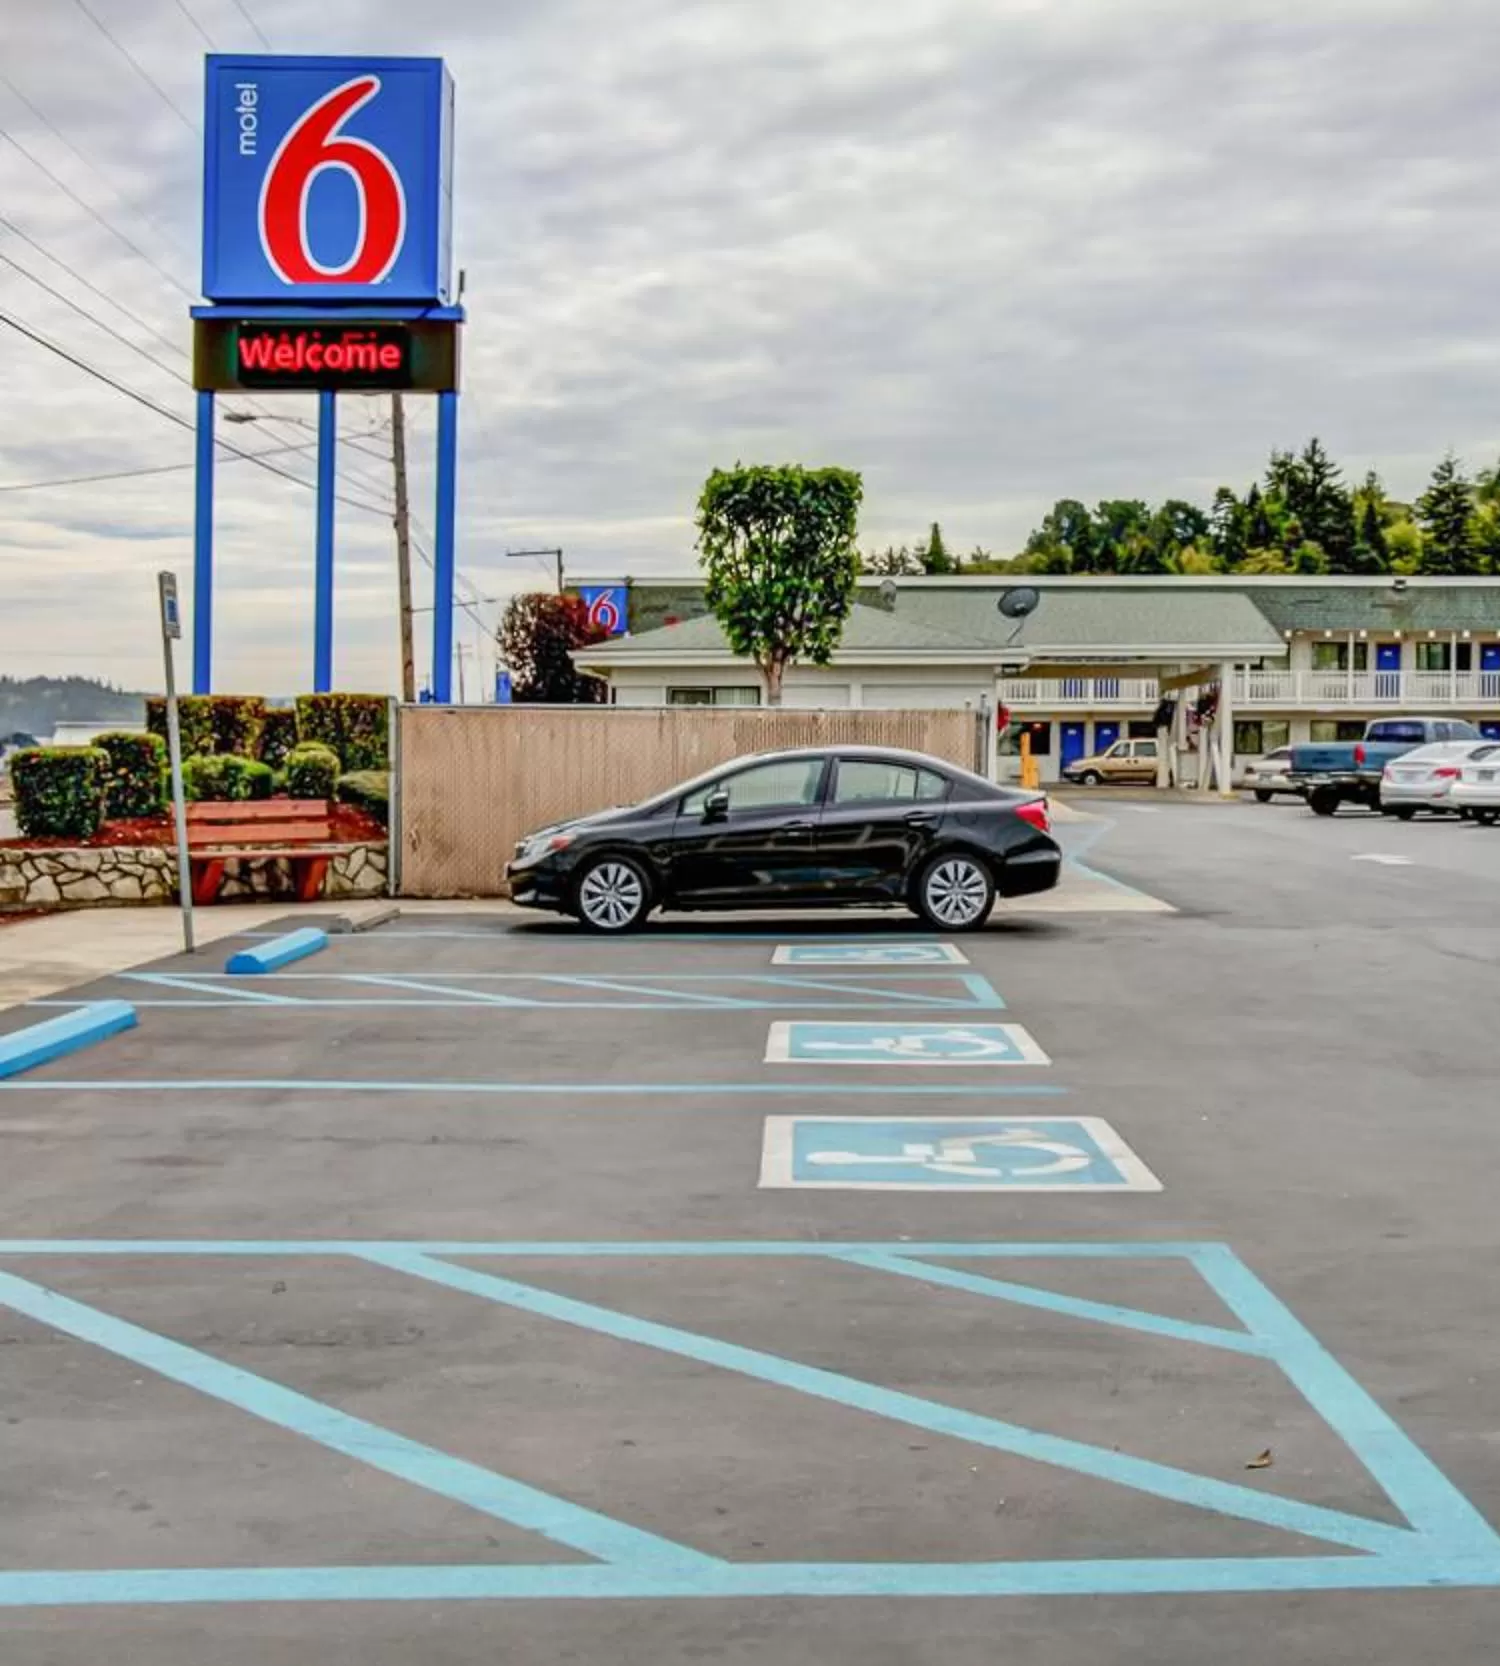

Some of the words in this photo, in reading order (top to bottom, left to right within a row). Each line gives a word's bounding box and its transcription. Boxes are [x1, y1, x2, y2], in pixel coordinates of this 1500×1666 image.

[234, 83, 257, 154] motel
[258, 75, 406, 284] 6
[239, 334, 401, 371] Welcome
[588, 588, 619, 633] 6
